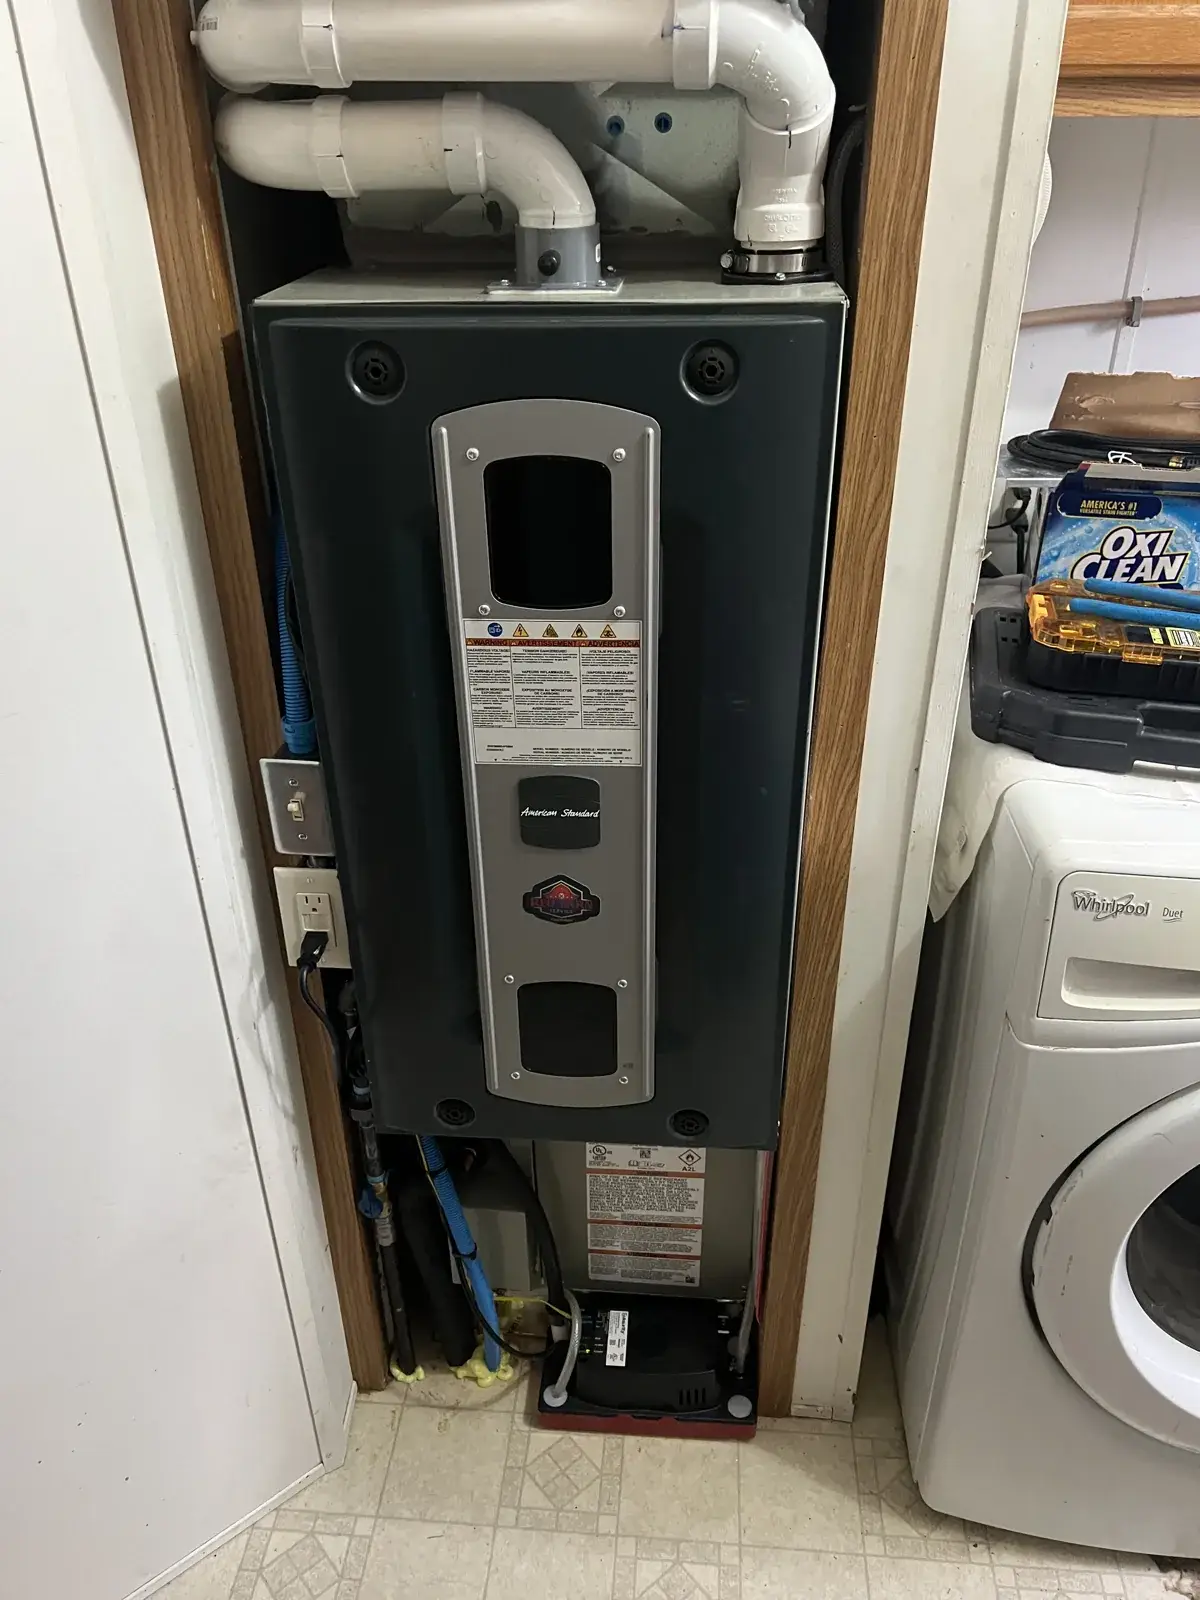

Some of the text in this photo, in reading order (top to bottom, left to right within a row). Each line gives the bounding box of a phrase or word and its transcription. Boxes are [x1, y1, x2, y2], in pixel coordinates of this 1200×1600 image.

[1080, 499, 1138, 511] AMERICA'S #1
[1101, 526, 1173, 560] OXI
[1072, 554, 1187, 582] CLEAN
[520, 806, 600, 818] American Standard
[1072, 891, 1183, 920] Whirlpool Duet
